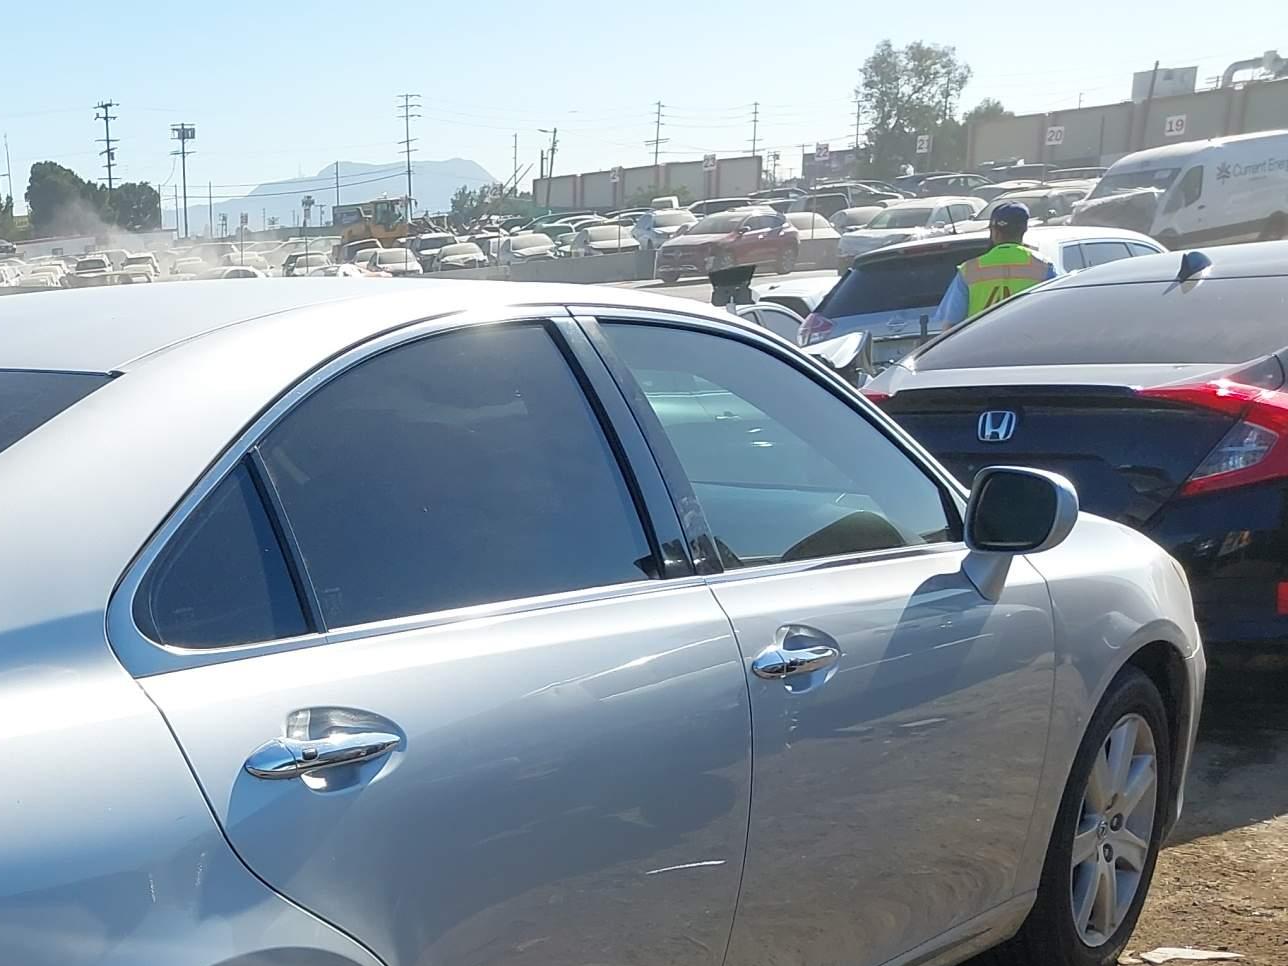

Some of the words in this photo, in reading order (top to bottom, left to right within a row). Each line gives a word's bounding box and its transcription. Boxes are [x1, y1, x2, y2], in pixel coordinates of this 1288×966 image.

[1167, 119, 1185, 133] 19
[1047, 129, 1063, 142] 20
[816, 147, 829, 158] 22
